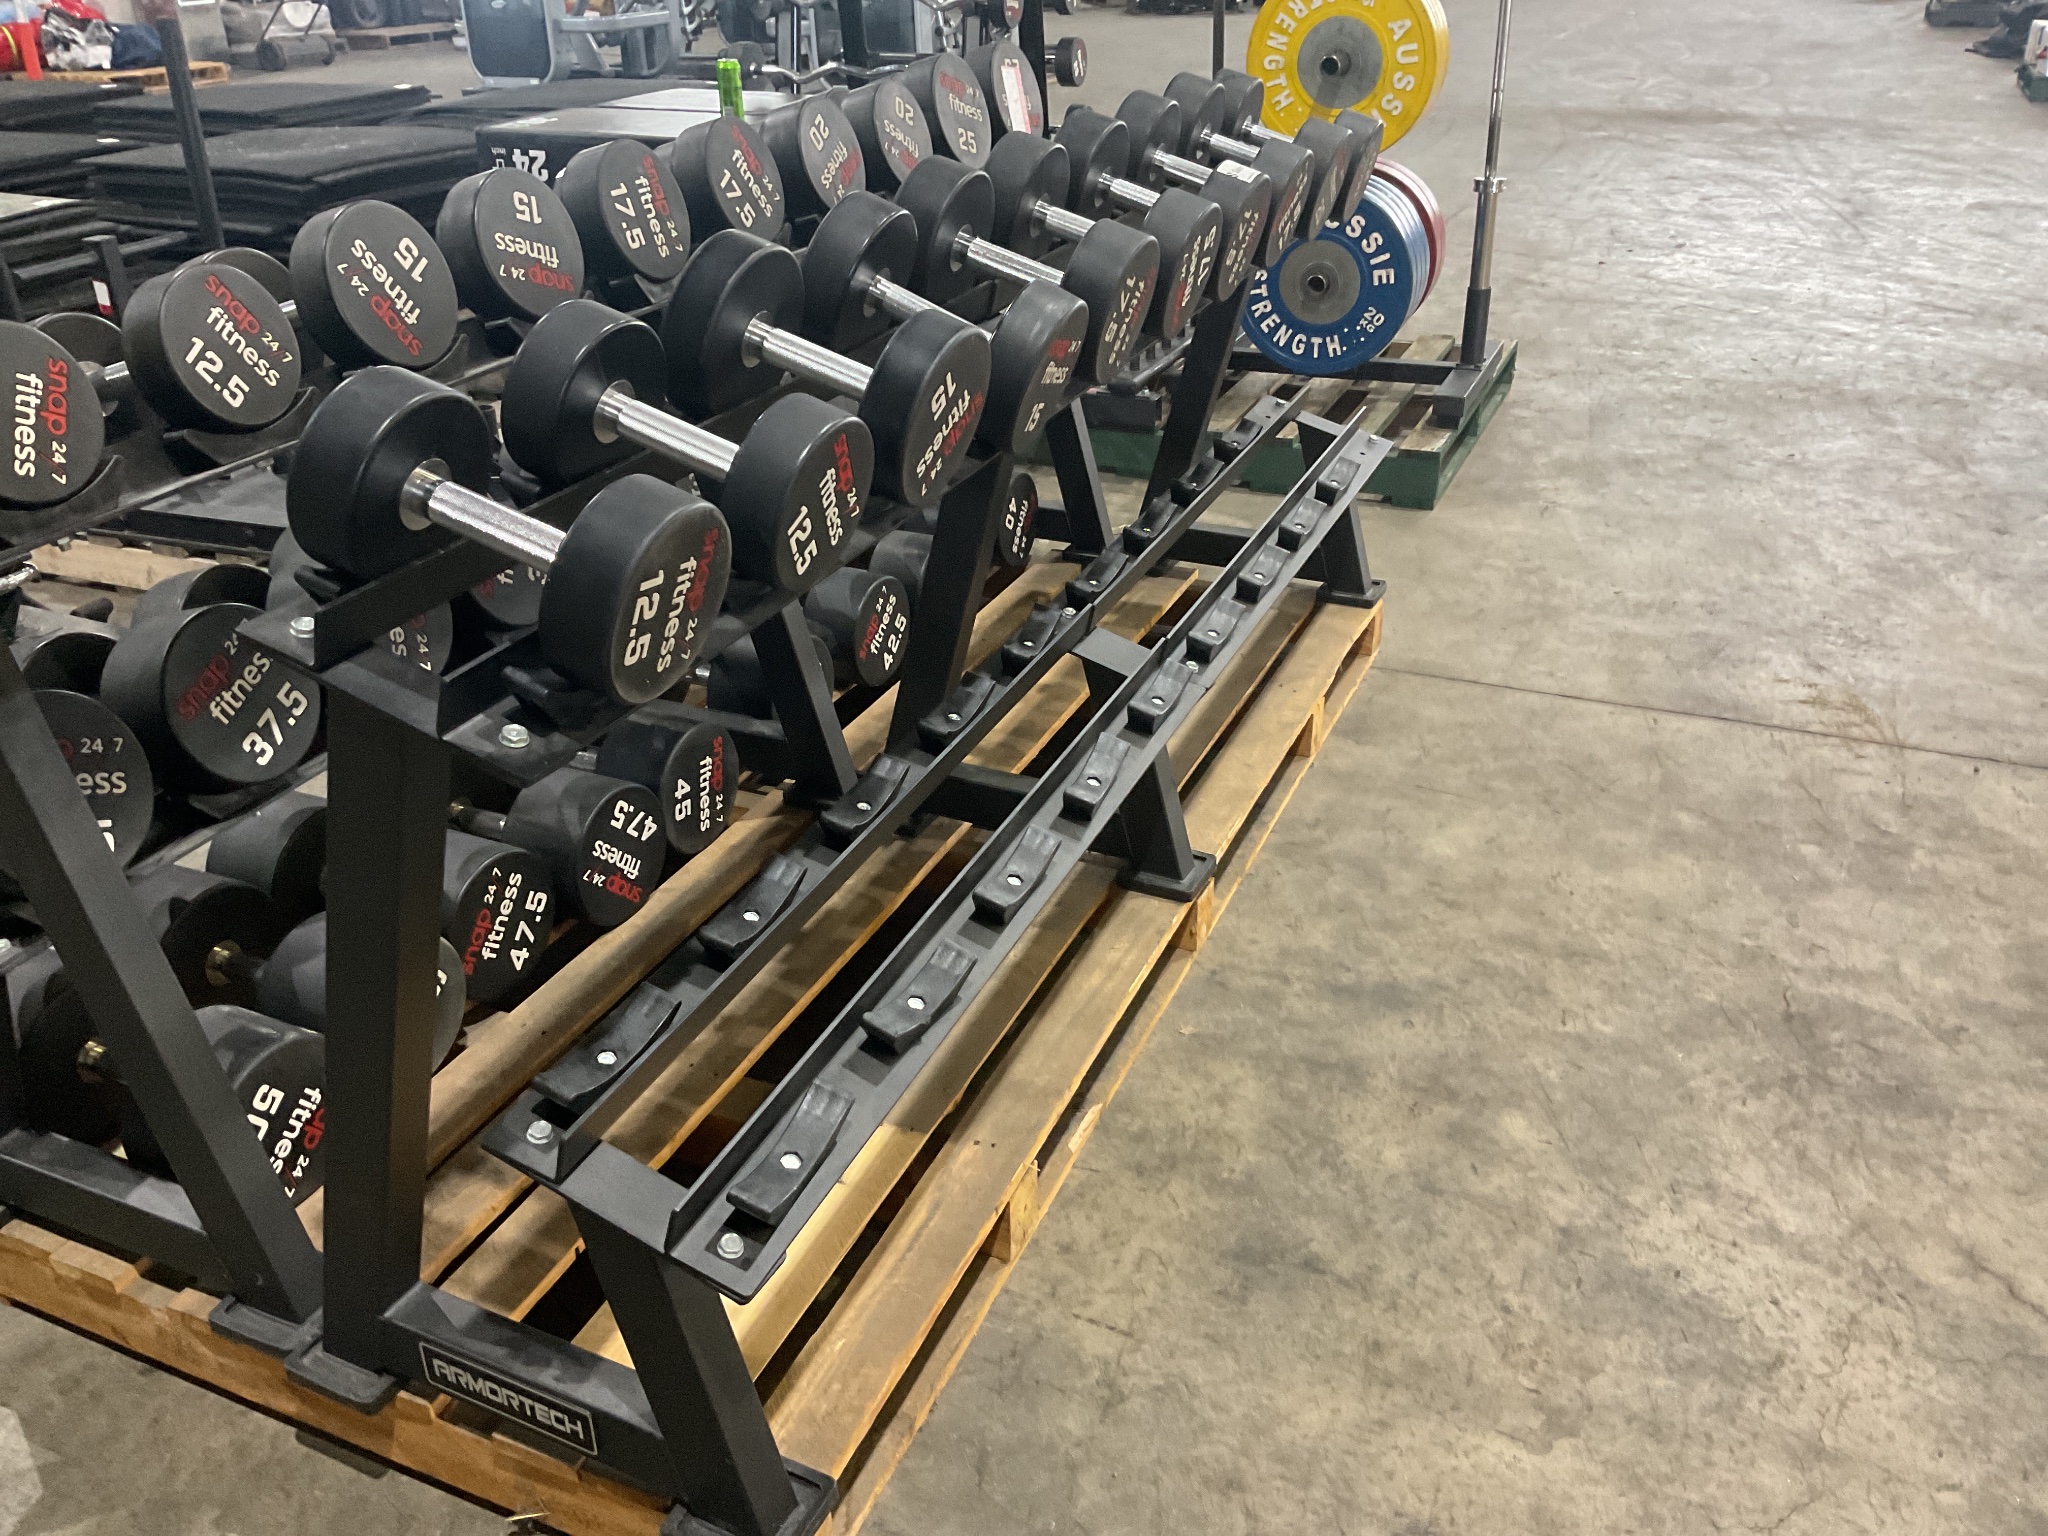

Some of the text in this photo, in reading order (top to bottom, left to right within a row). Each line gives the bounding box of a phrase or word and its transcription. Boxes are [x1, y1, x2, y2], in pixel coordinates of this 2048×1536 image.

[1263, 0, 1335, 111] RENGTH
[809, 113, 829, 150] 20
[895, 96, 914, 126] 20
[949, 93, 983, 122] fitness
[512, 148, 549, 181] 24
[821, 140, 848, 189] fitness
[884, 119, 919, 159] fitness
[957, 127, 977, 154] 25
[513, 191, 542, 224] 15
[643, 154, 671, 216] snap
[720, 169, 756, 228] 17.5
[732, 149, 773, 218] fitness
[610, 182, 646, 250] 17.5
[635, 175, 670, 258] fitness
[393, 237, 428, 283] 15
[494, 232, 559, 269] fitness
[527, 261, 575, 292] snap
[1325, 214, 1395, 286] SSIE
[351, 239, 421, 325] fitness
[204, 273, 294, 363] snap 24/7
[369, 294, 423, 357] snap
[1250, 269, 1342, 358] STRENGTH
[1363, 306, 1385, 326] 20
[184, 336, 250, 408] 12.5
[206, 306, 281, 387] fitness
[1040, 360, 1069, 385] fitness
[14, 372, 44, 478] fitness
[40, 357, 68, 485] snap 24/7
[931, 371, 956, 421] 15
[1024, 402, 1045, 432] 15
[834, 433, 854, 492] snap
[916, 389, 971, 478] fitness
[819, 467, 843, 546] fitness
[1005, 497, 1017, 531] 40
[787, 505, 818, 576] 12.5
[624, 569, 664, 667] 12.5
[656, 556, 698, 673] fitness
[858, 613, 880, 660] snap
[871, 594, 897, 655] fitness
[883, 612, 908, 671] 42.5
[176, 654, 230, 722] snap
[210, 652, 272, 725] fitnes
[242, 680, 308, 766] 37.5
[699, 756, 713, 832] fitness
[711, 736, 723, 791] snap
[610, 800, 658, 841] 47.5
[674, 778, 692, 821] 45
[592, 840, 641, 880] fitness
[605, 872, 643, 903] snap
[463, 908, 494, 976] snap
[481, 872, 522, 961] fitness
[510, 890, 548, 971] 47.5
[269, 1087, 322, 1175] fitnes
[432, 1357, 585, 1440] ARMORTECH
